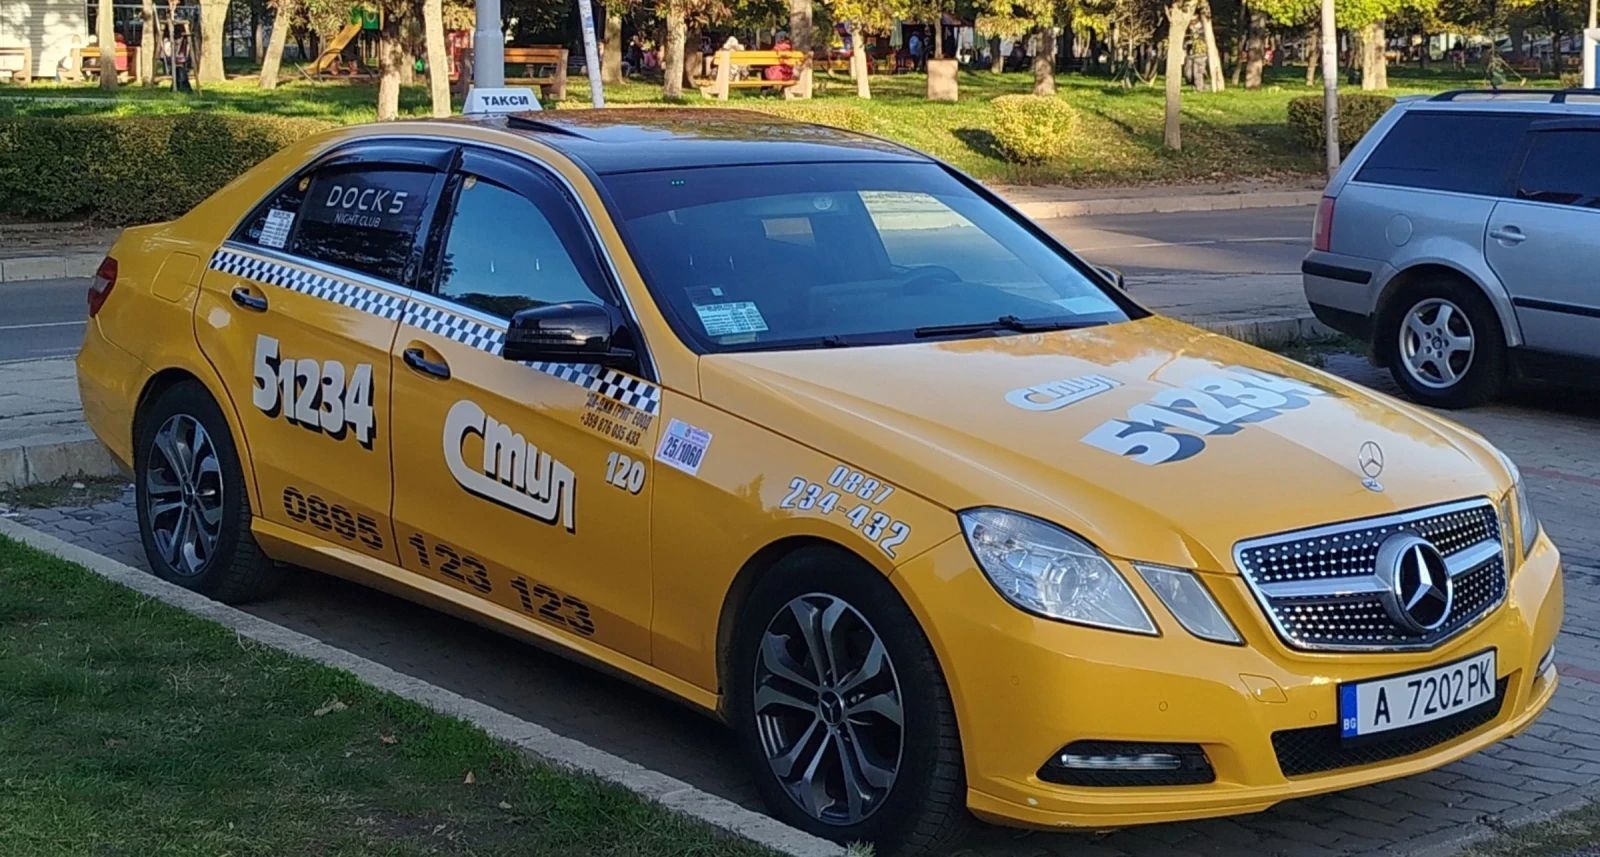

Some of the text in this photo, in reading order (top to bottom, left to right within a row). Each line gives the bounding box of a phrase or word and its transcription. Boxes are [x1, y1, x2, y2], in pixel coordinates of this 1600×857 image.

[481, 95, 529, 106] ТАКСИ
[325, 185, 408, 214] DOCK 5
[334, 212, 382, 228] NIGHT CLUB
[252, 333, 377, 451] 51234
[580, 411, 641, 446] +359 876 035 433
[1079, 366, 1327, 467] 51234
[663, 436, 703, 469] 25/1060
[606, 451, 646, 496] 120
[827, 464, 895, 505] 0887
[779, 476, 911, 560] 234-432
[282, 486, 595, 636] 0895 123 123
[1343, 717, 1357, 731] BG
[1374, 686, 1391, 726] A
